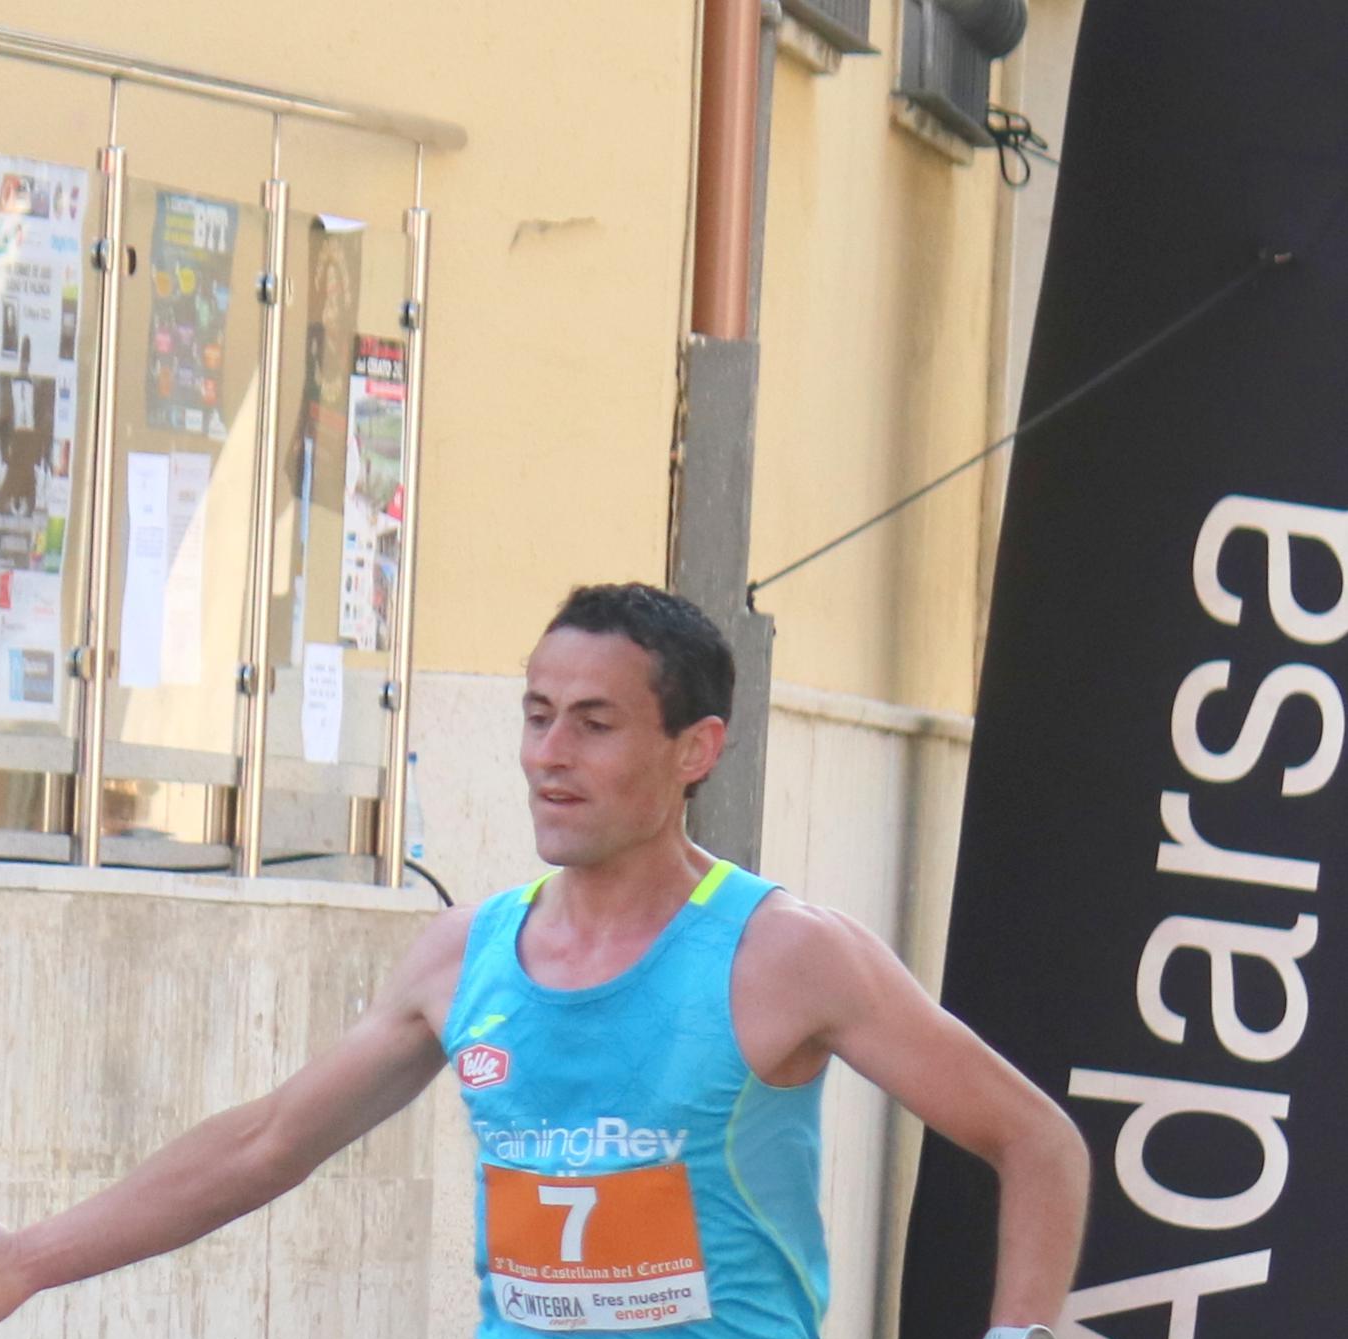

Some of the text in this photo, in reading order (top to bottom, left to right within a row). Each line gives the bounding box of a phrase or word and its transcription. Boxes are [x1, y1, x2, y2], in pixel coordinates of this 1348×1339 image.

[537, 1184, 598, 1263] 7
[540, 1264, 610, 1280] Castellana
[612, 1265, 633, 1279] del
[636, 1256, 695, 1276] Cerrato
[523, 1292, 586, 1319] INTEGRA
[592, 1286, 693, 1308] Eres nuestra
